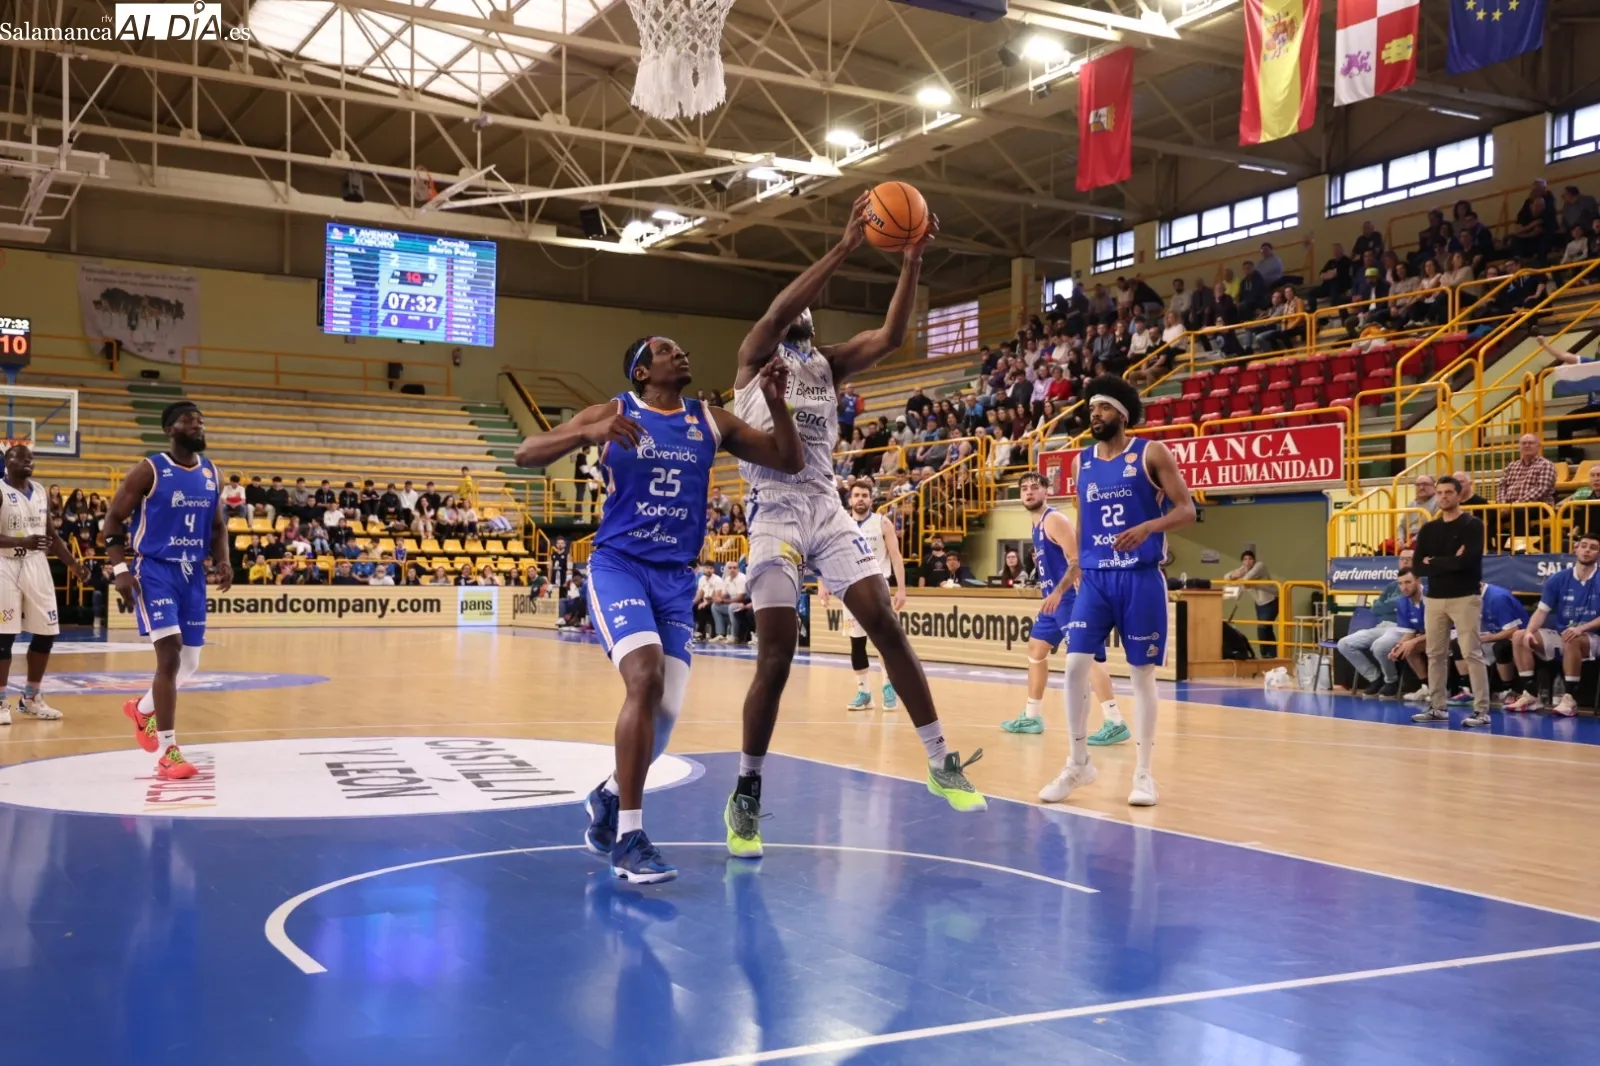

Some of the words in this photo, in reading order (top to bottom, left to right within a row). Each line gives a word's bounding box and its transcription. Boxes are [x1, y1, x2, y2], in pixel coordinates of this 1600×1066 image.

[388, 293, 437, 313] 07:32
[0, 318, 30, 330] 07:32
[390, 314, 399, 326] 0
[427, 318, 434, 329] 1
[0, 335, 28, 355] 10
[643, 450, 697, 463] avenida
[1173, 431, 1301, 464] MANCA
[1191, 468, 1210, 486] LA
[1217, 457, 1334, 483] HUMANIDAD
[649, 467, 682, 497] 25
[7, 493, 17, 503] 15
[635, 501, 688, 520] Xoborg
[1100, 503, 1126, 527] 22
[185, 513, 196, 533] 4
[1092, 533, 1117, 546] Xob
[1038, 560, 1045, 576] 6
[1332, 566, 1399, 582] perfumerías
[460, 598, 493, 614] pans
[513, 593, 537, 620] pans
[424, 739, 576, 801] CASTILLA
